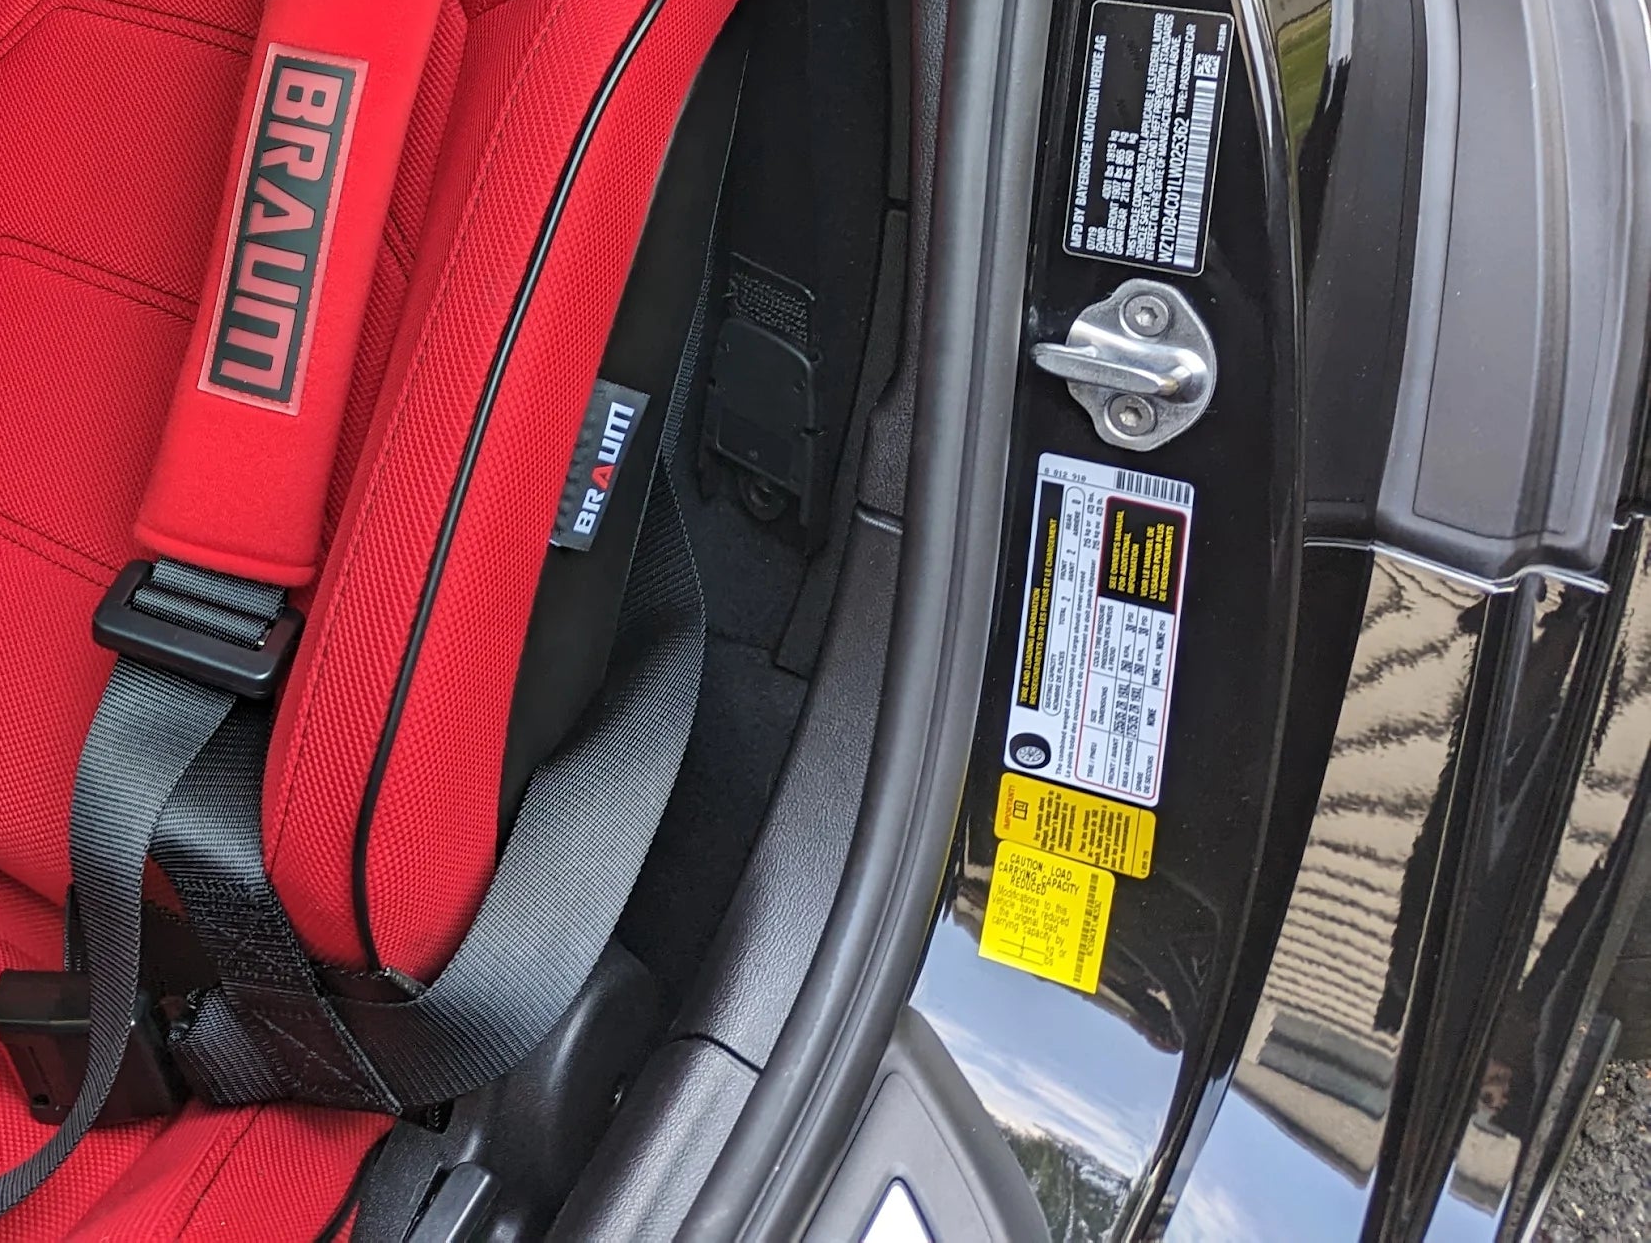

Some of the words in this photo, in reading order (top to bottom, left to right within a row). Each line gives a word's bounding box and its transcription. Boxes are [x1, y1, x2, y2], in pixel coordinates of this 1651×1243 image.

[1093, 34, 1106, 51] AG
[1088, 51, 1104, 88] WERKE
[1082, 88, 1099, 141] MOTOREN
[1136, 152, 1147, 164] TO
[1156, 116, 1189, 264] WZ1DB4C01LW025362
[1184, 22, 1196, 42] CAR
[1074, 140, 1093, 206] BAYERISCHE
[219, 68, 343, 391] BRAUM
[1072, 207, 1085, 223] BY
[1107, 200, 1119, 228] FRONT
[1069, 222, 1083, 248] MFD
[573, 401, 635, 536] BRAUM
[1028, 586, 1040, 637] INFORMATION
[1024, 636, 1034, 669] LOADING
[1022, 669, 1031, 686] AND
[997, 861, 1037, 882] CARRYING
[1040, 874, 1079, 895] CAPACITY
[1009, 875, 1046, 895] REDUCED
[1050, 865, 1072, 881] LOAD
